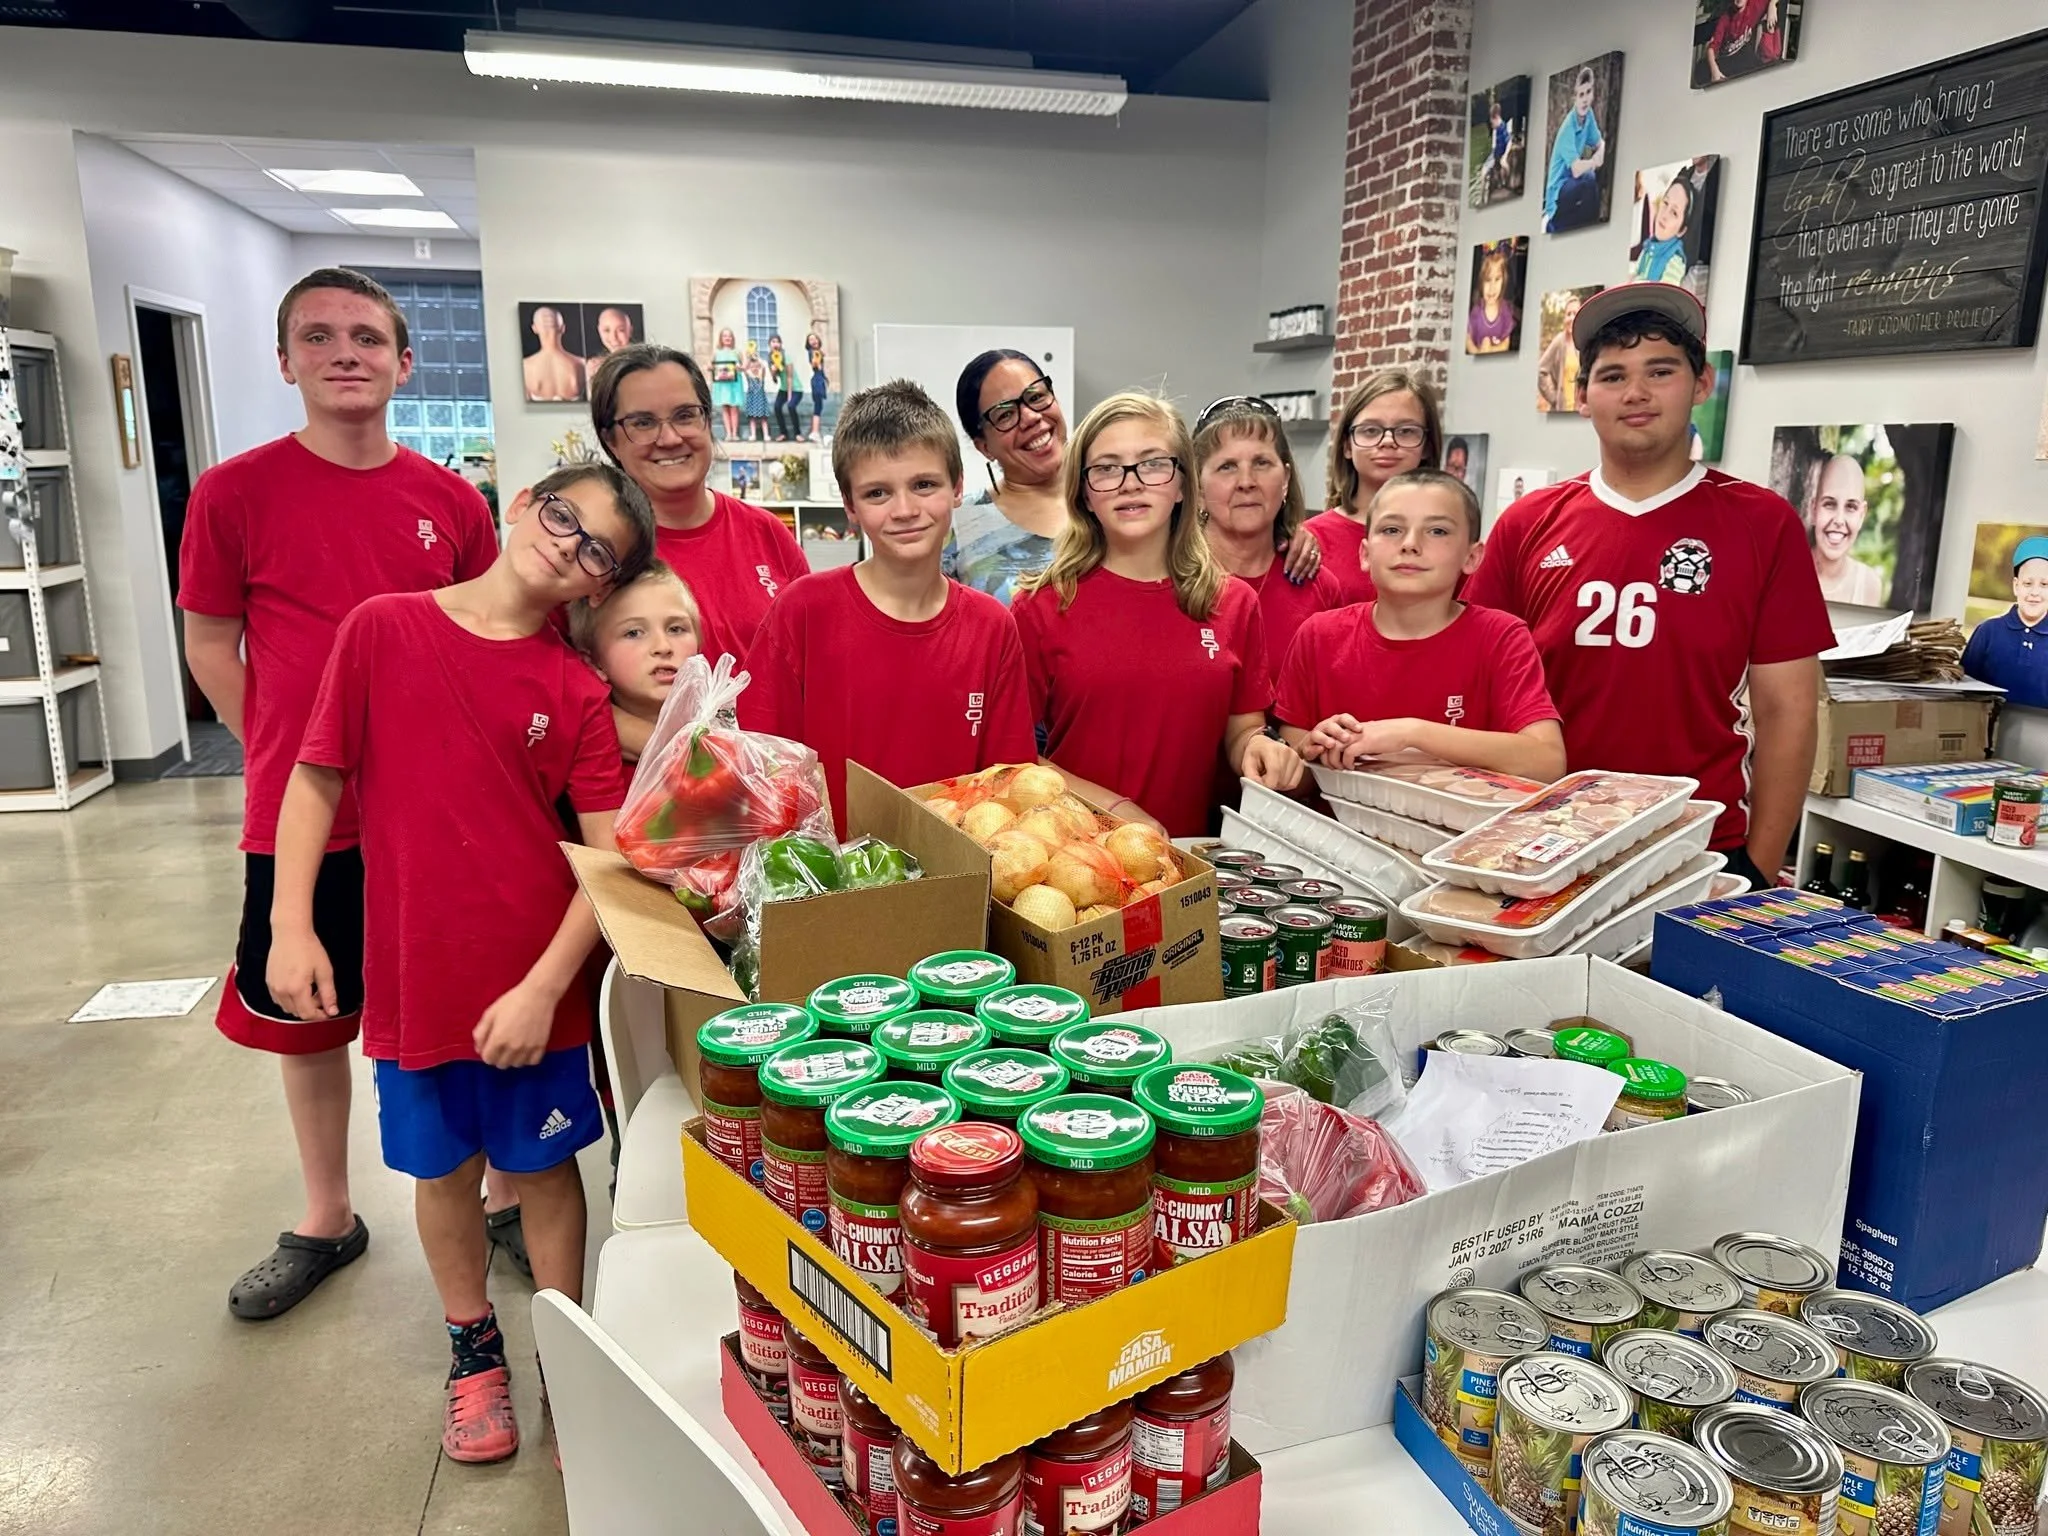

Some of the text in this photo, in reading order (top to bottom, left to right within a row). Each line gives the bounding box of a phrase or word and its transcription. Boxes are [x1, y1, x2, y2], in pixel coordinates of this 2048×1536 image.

[1785, 80, 1995, 159] There are some who bring a
[1869, 168, 1885, 196] so
[1888, 156, 1926, 201] great
[1931, 147, 1944, 184] to
[1950, 141, 1973, 181] the
[1979, 126, 2027, 174] world
[1798, 194, 2020, 259] that even after they are gone
[1780, 256, 1969, 313] the light remains
[1878, 313, 1941, 335] GODMOTHER
[1540, 558, 1574, 569] adidas
[1575, 580, 1658, 648] 26
[1070, 932, 1104, 953] 6-12 PK
[1335, 930, 1363, 939] ARVEST
[1072, 950, 1091, 966] 1.75
[1093, 946, 1104, 958] FL
[1105, 940, 1117, 954] OZ
[1162, 929, 1204, 963] ORIGINAL
[1332, 945, 1348, 958] ICED
[1330, 956, 1364, 971] OMATOES
[850, 1023, 871, 1032] MILD
[748, 1054, 769, 1064] MILD
[916, 1062, 938, 1072] MILD
[1081, 1054, 1106, 1064] MILD
[1071, 1071, 1090, 1084] MILD
[539, 1118, 573, 1140] adidas
[1192, 1126, 1215, 1137] MILD
[731, 1147, 742, 1156] 10
[843, 1142, 863, 1154] MILD
[1070, 1158, 1094, 1170] MILD
[784, 1191, 795, 1201] 10
[1188, 1186, 1212, 1197] MILD
[865, 1209, 888, 1219] MILD
[1167, 1199, 1222, 1221] CHUNKY
[1558, 1212, 1599, 1229] MAMA
[1604, 1201, 1644, 1219] COZZI
[1154, 1214, 1223, 1248] ALSA
[1597, 1219, 1619, 1230] CRUST
[848, 1222, 901, 1245] CHUNKY
[1062, 1234, 1122, 1246] Nutrition Facts
[1452, 1235, 1482, 1254] BEST
[1483, 1230, 1494, 1244] IF
[1497, 1218, 1526, 1239] USED
[1528, 1212, 1544, 1230] BY
[1573, 1232, 1599, 1246] BLOODY
[1619, 1223, 1639, 1233] STYLE
[1856, 1219, 1898, 1247] Spaghetti
[831, 1228, 904, 1272] SALSA
[1449, 1227, 1544, 1269] JAN 13 2027 S1R6
[1603, 1248, 1634, 1263] FROZEN
[1840, 1238, 1894, 1272] SAP: 399573
[1062, 1264, 1123, 1278] Calories 10
[1848, 1264, 1892, 1293] 12 x 32 oz
[1863, 1261, 1893, 1282] 824826
[1120, 1335, 1162, 1365] CASA
[1550, 1339, 1582, 1354] EAPPLE
[1107, 1344, 1171, 1392] MAMITA
[1479, 1359, 1501, 1368] Swee
[805, 1382, 836, 1393] REGG
[1470, 1376, 1497, 1387] PINEA
[1740, 1374, 1767, 1389] Sweet
[1474, 1385, 1496, 1396] CHU
[1743, 1383, 1779, 1399] Harvest
[795, 1396, 841, 1420] Tradit
[1088, 1455, 1129, 1487] REGGAN
[1947, 1474, 1965, 1486] JUICE
[1066, 1482, 1130, 1516] Traditio
[1843, 1499, 1860, 1511] JUICE
[1462, 1482, 1500, 1534] Sweet
